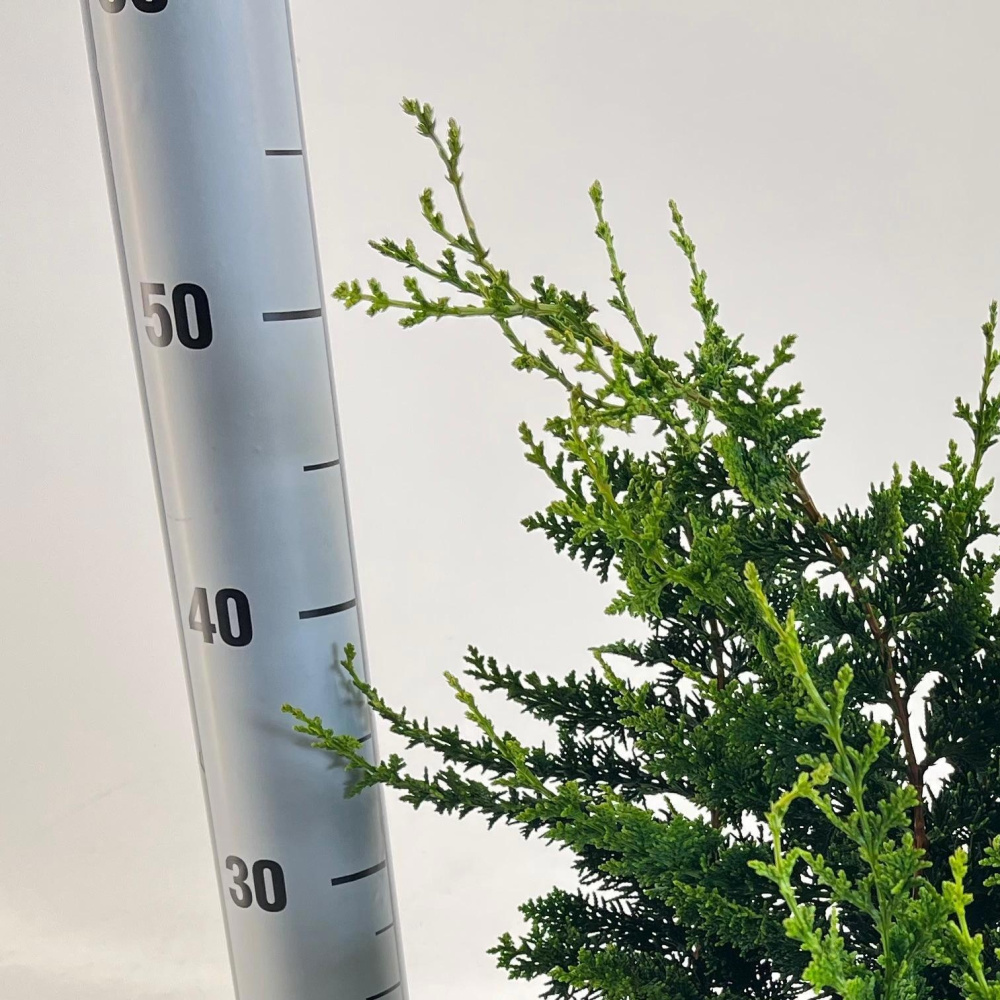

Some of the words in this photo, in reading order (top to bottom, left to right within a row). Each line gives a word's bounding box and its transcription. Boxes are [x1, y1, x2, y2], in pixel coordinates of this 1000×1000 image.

[139, 282, 213, 350] 50
[188, 586, 253, 647] 40
[225, 855, 287, 913] 30
